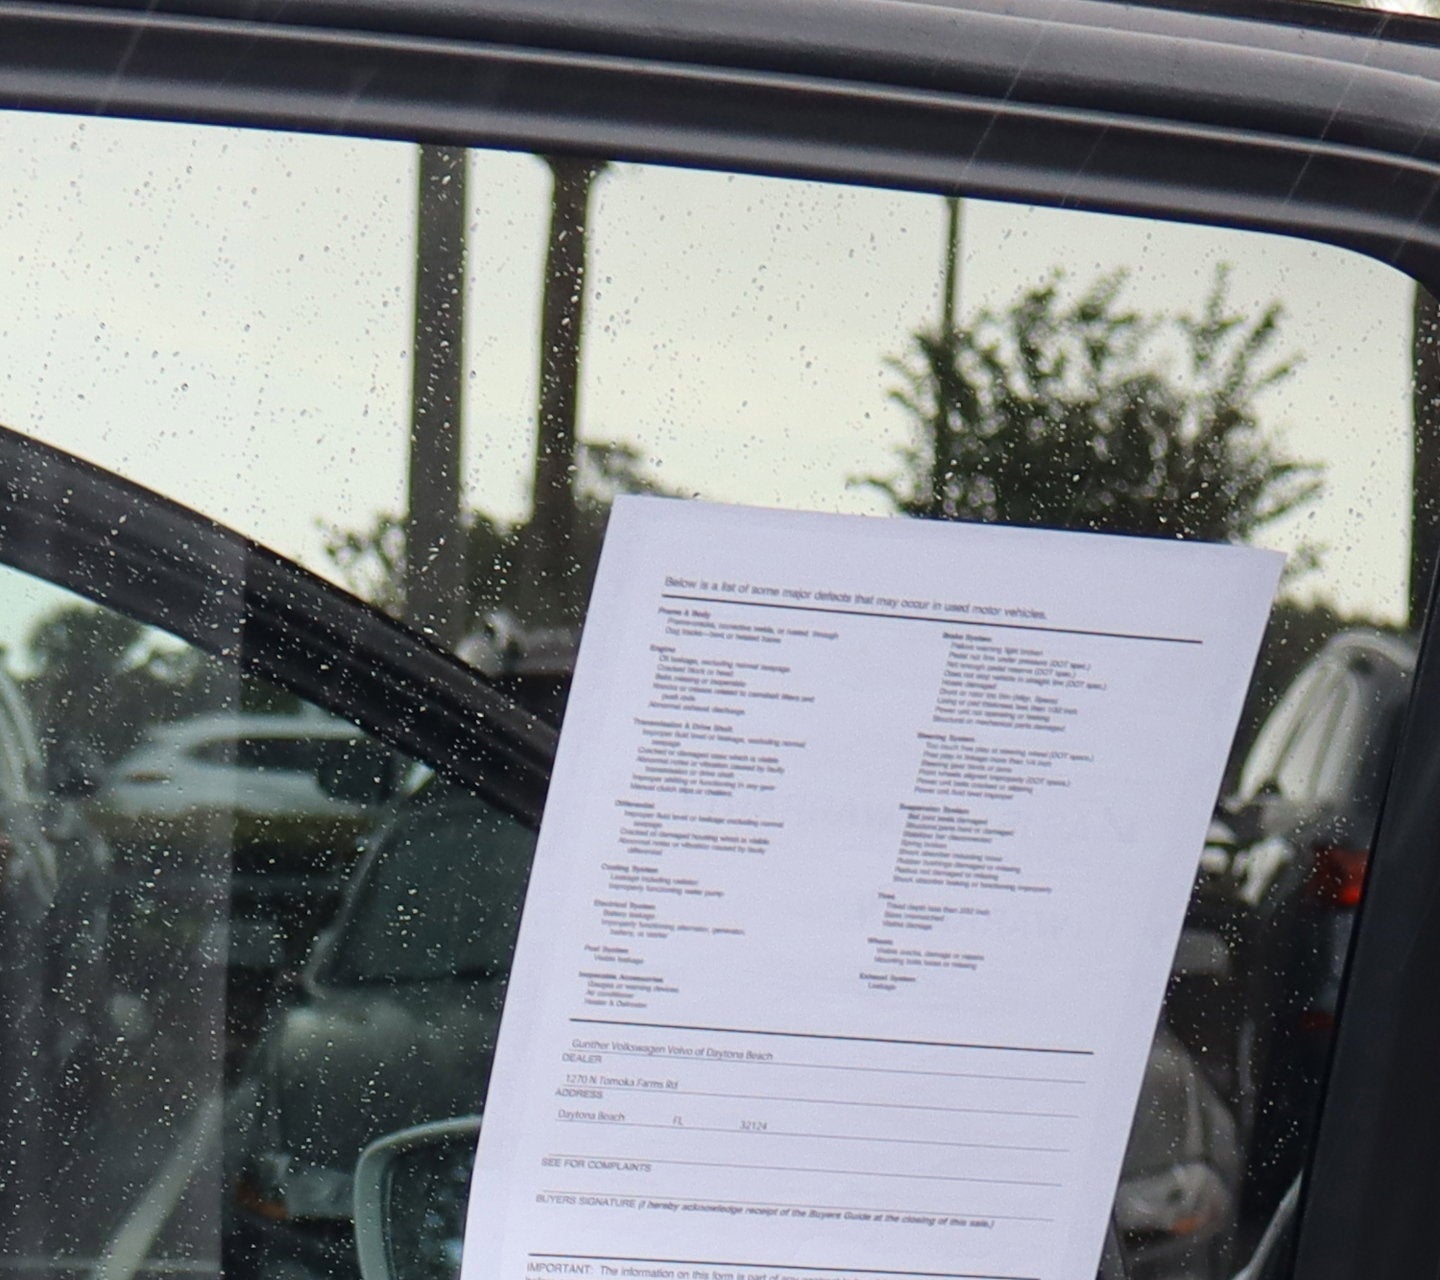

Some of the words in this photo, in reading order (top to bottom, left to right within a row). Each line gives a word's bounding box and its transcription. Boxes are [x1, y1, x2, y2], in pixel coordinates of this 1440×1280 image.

[665, 576, 697, 589] Below
[699, 580, 709, 591] is
[711, 583, 718, 591] a
[721, 581, 736, 593] list
[737, 583, 750, 594] of
[751, 586, 780, 597] some
[782, 589, 812, 600] major
[814, 591, 852, 603] defects
[854, 594, 874, 605] that
[876, 597, 899, 609] may
[900, 600, 930, 610] occur
[932, 601, 942, 611] in
[944, 604, 970, 613] used
[972, 606, 1002, 616] motor
[1004, 608, 1046, 620] vehicles.
[562, 1053, 602, 1064] DEALER
[555, 1088, 603, 1099] ADDRESS
[541, 1157, 562, 1168] SEE
[564, 1159, 586, 1169] FOR
[588, 1160, 652, 1172] COMPLAINTS
[600, 1265, 619, 1276] The
[621, 1267, 674, 1278] information
[677, 1271, 690, 1279] on
[692, 1270, 709, 1280] this
[712, 1271, 734, 1280] form
